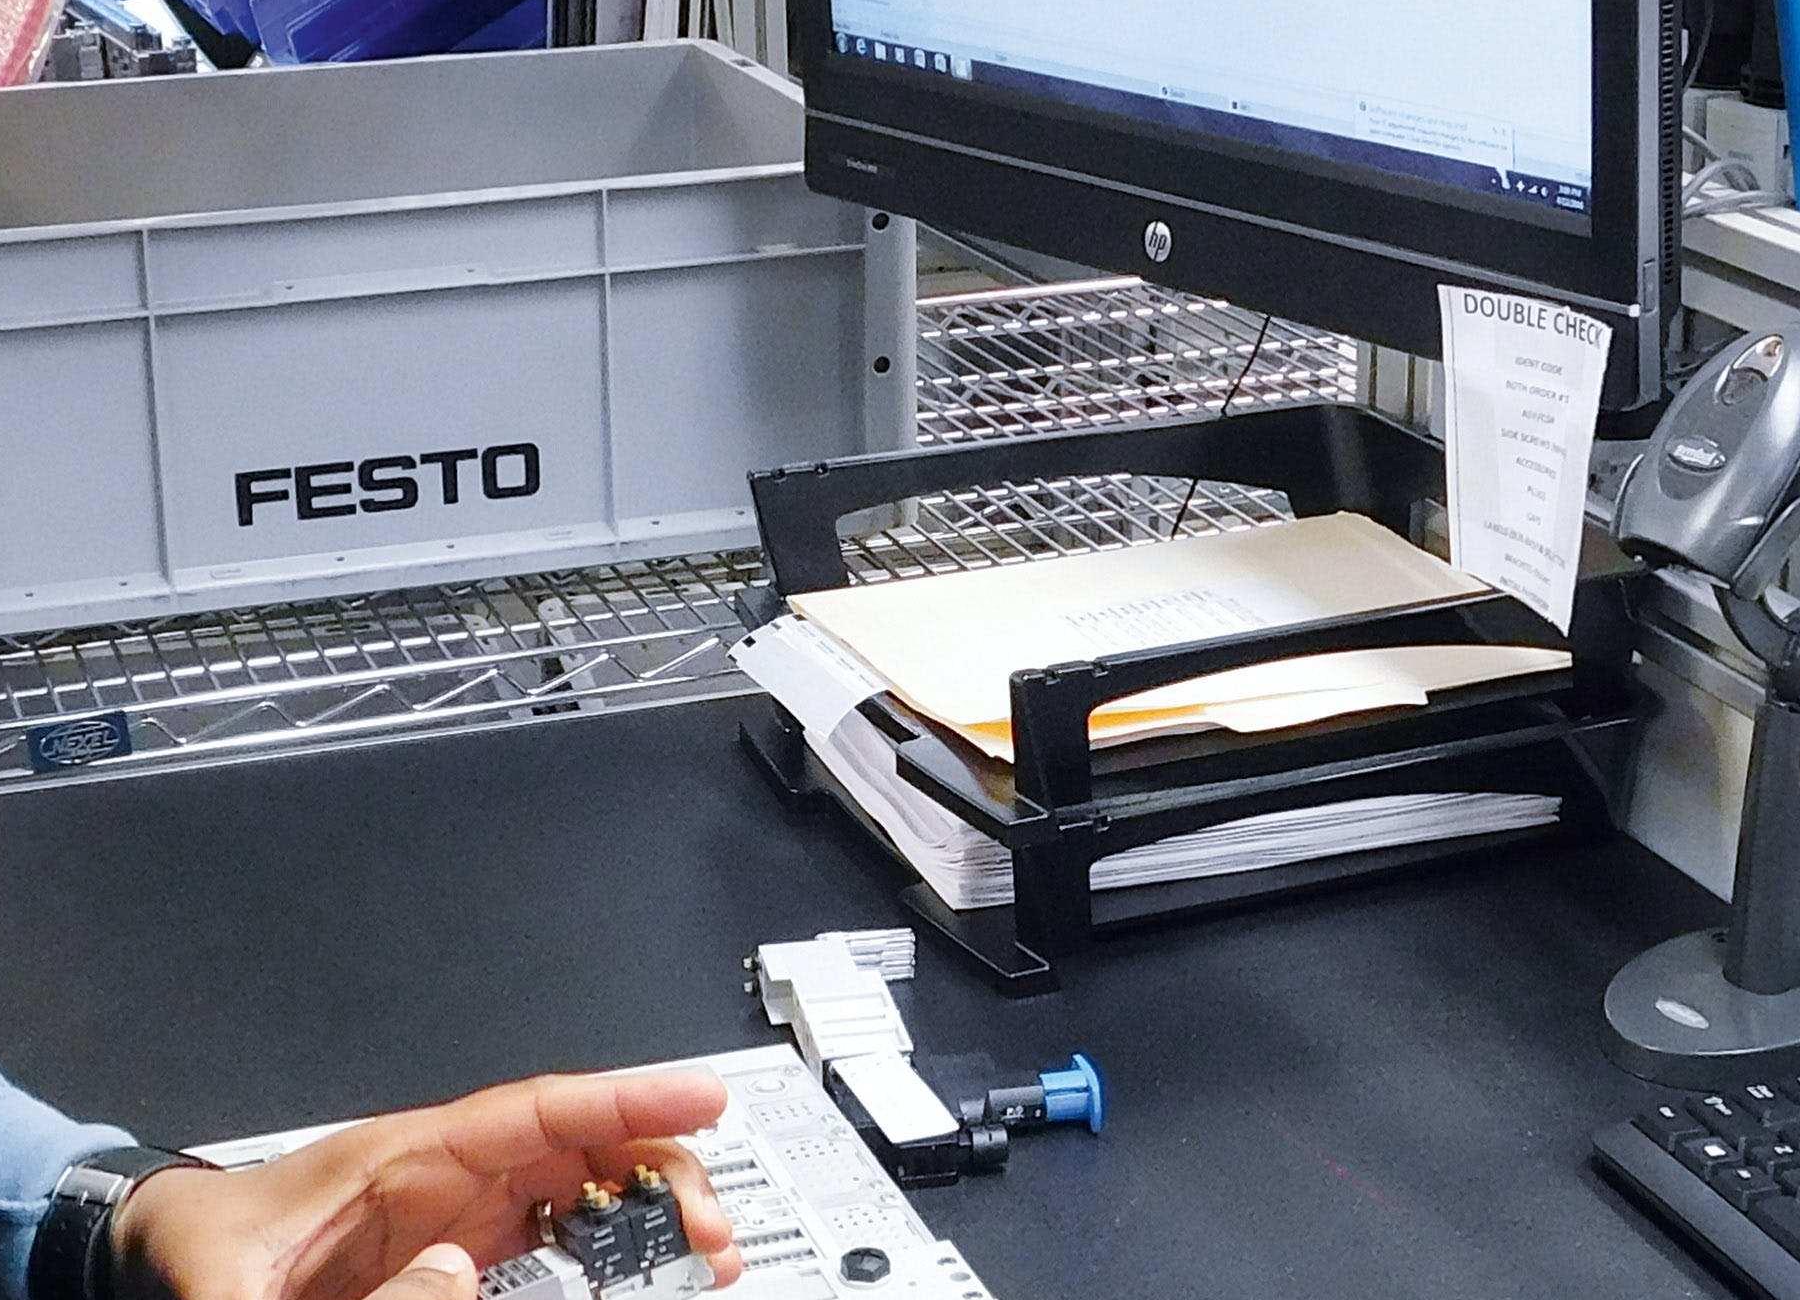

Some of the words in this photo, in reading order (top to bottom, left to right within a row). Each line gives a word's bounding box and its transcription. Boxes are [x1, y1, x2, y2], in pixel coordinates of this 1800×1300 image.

[1147, 221, 1170, 261] hp
[1464, 293, 1547, 330] DOUBLE
[1553, 312, 1604, 350] CHECK
[1505, 379, 1528, 392] BOTH
[234, 442, 541, 527] FESTO
